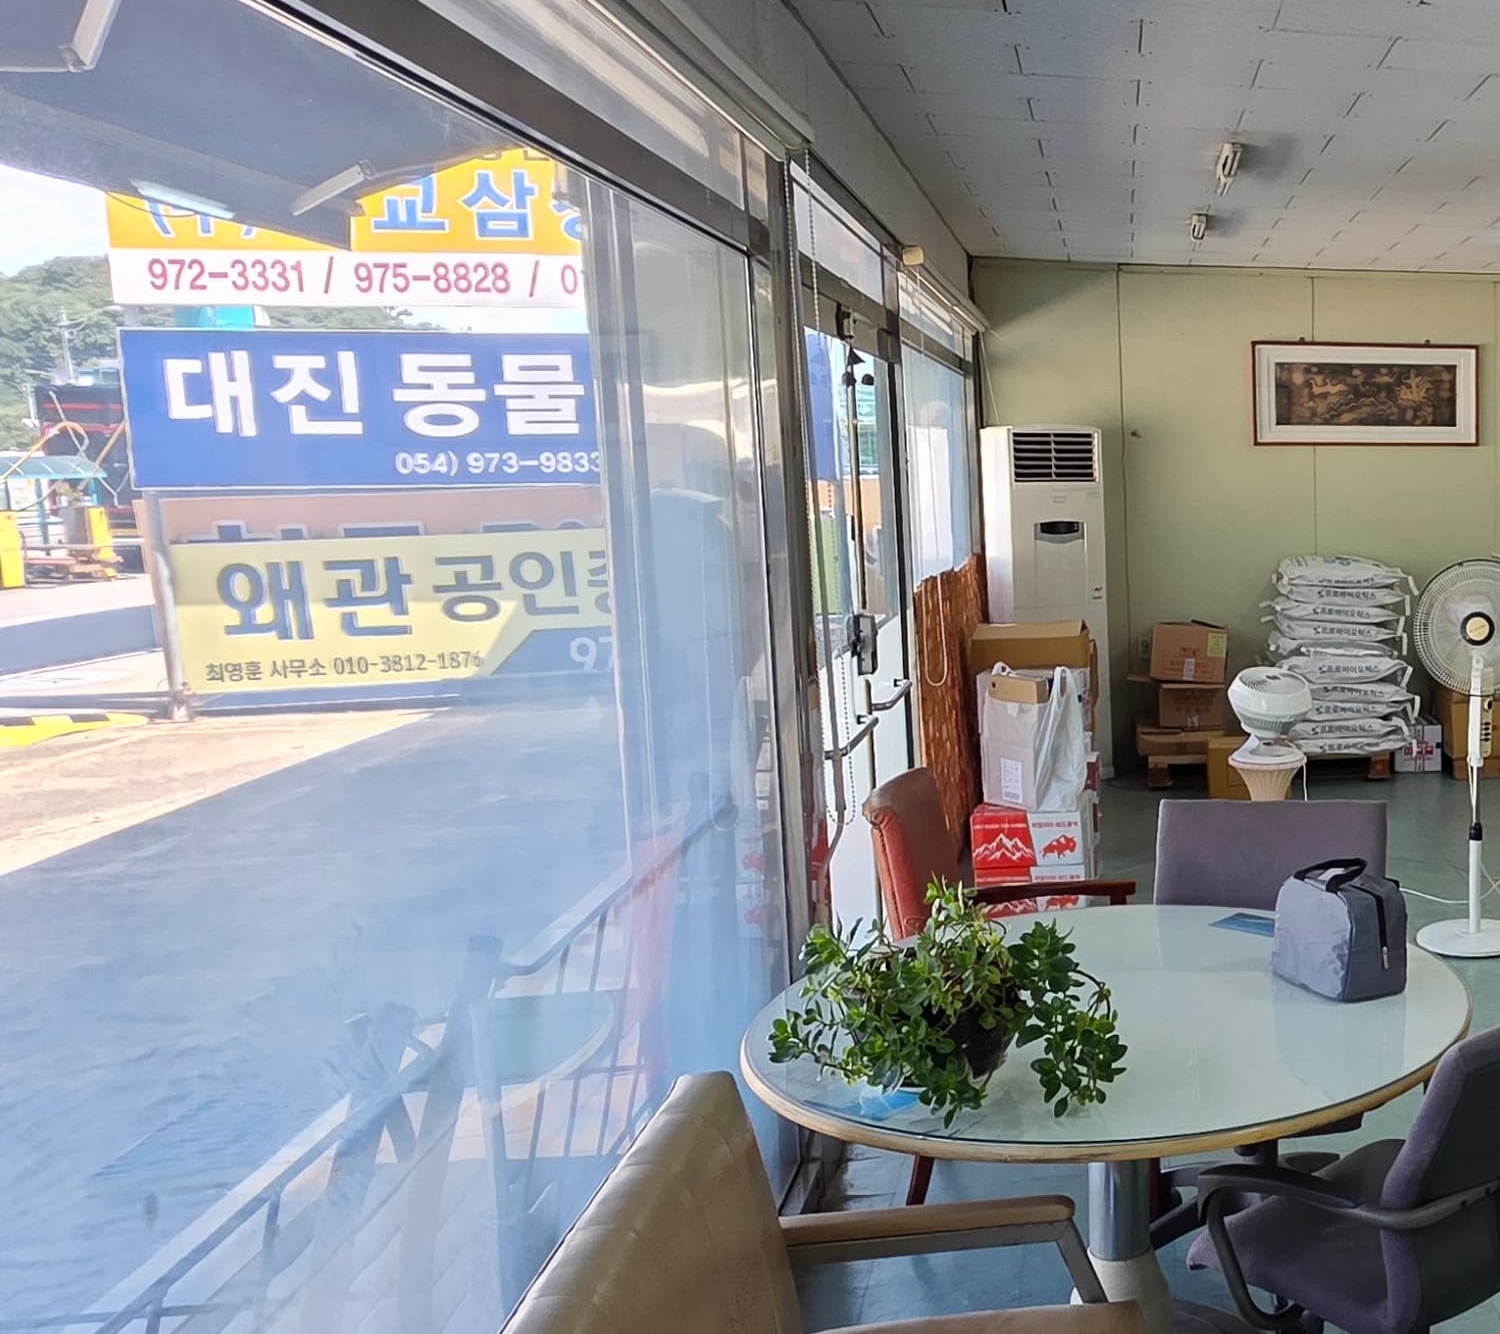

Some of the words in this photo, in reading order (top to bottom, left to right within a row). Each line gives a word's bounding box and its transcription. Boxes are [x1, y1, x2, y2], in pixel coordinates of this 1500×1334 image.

[148, 257, 305, 292] 972-3331
[354, 263, 511, 294] 975-8828
[161, 350, 366, 438] 대진
[392, 353, 586, 438] 동물
[395, 450, 459, 478] 054)
[467, 451, 601, 476] 973-9833
[217, 556, 413, 641] 왜관
[205, 657, 264, 683] 최영훈
[270, 657, 327, 680] 사무소
[333, 650, 483, 677] 010-3812-1876
